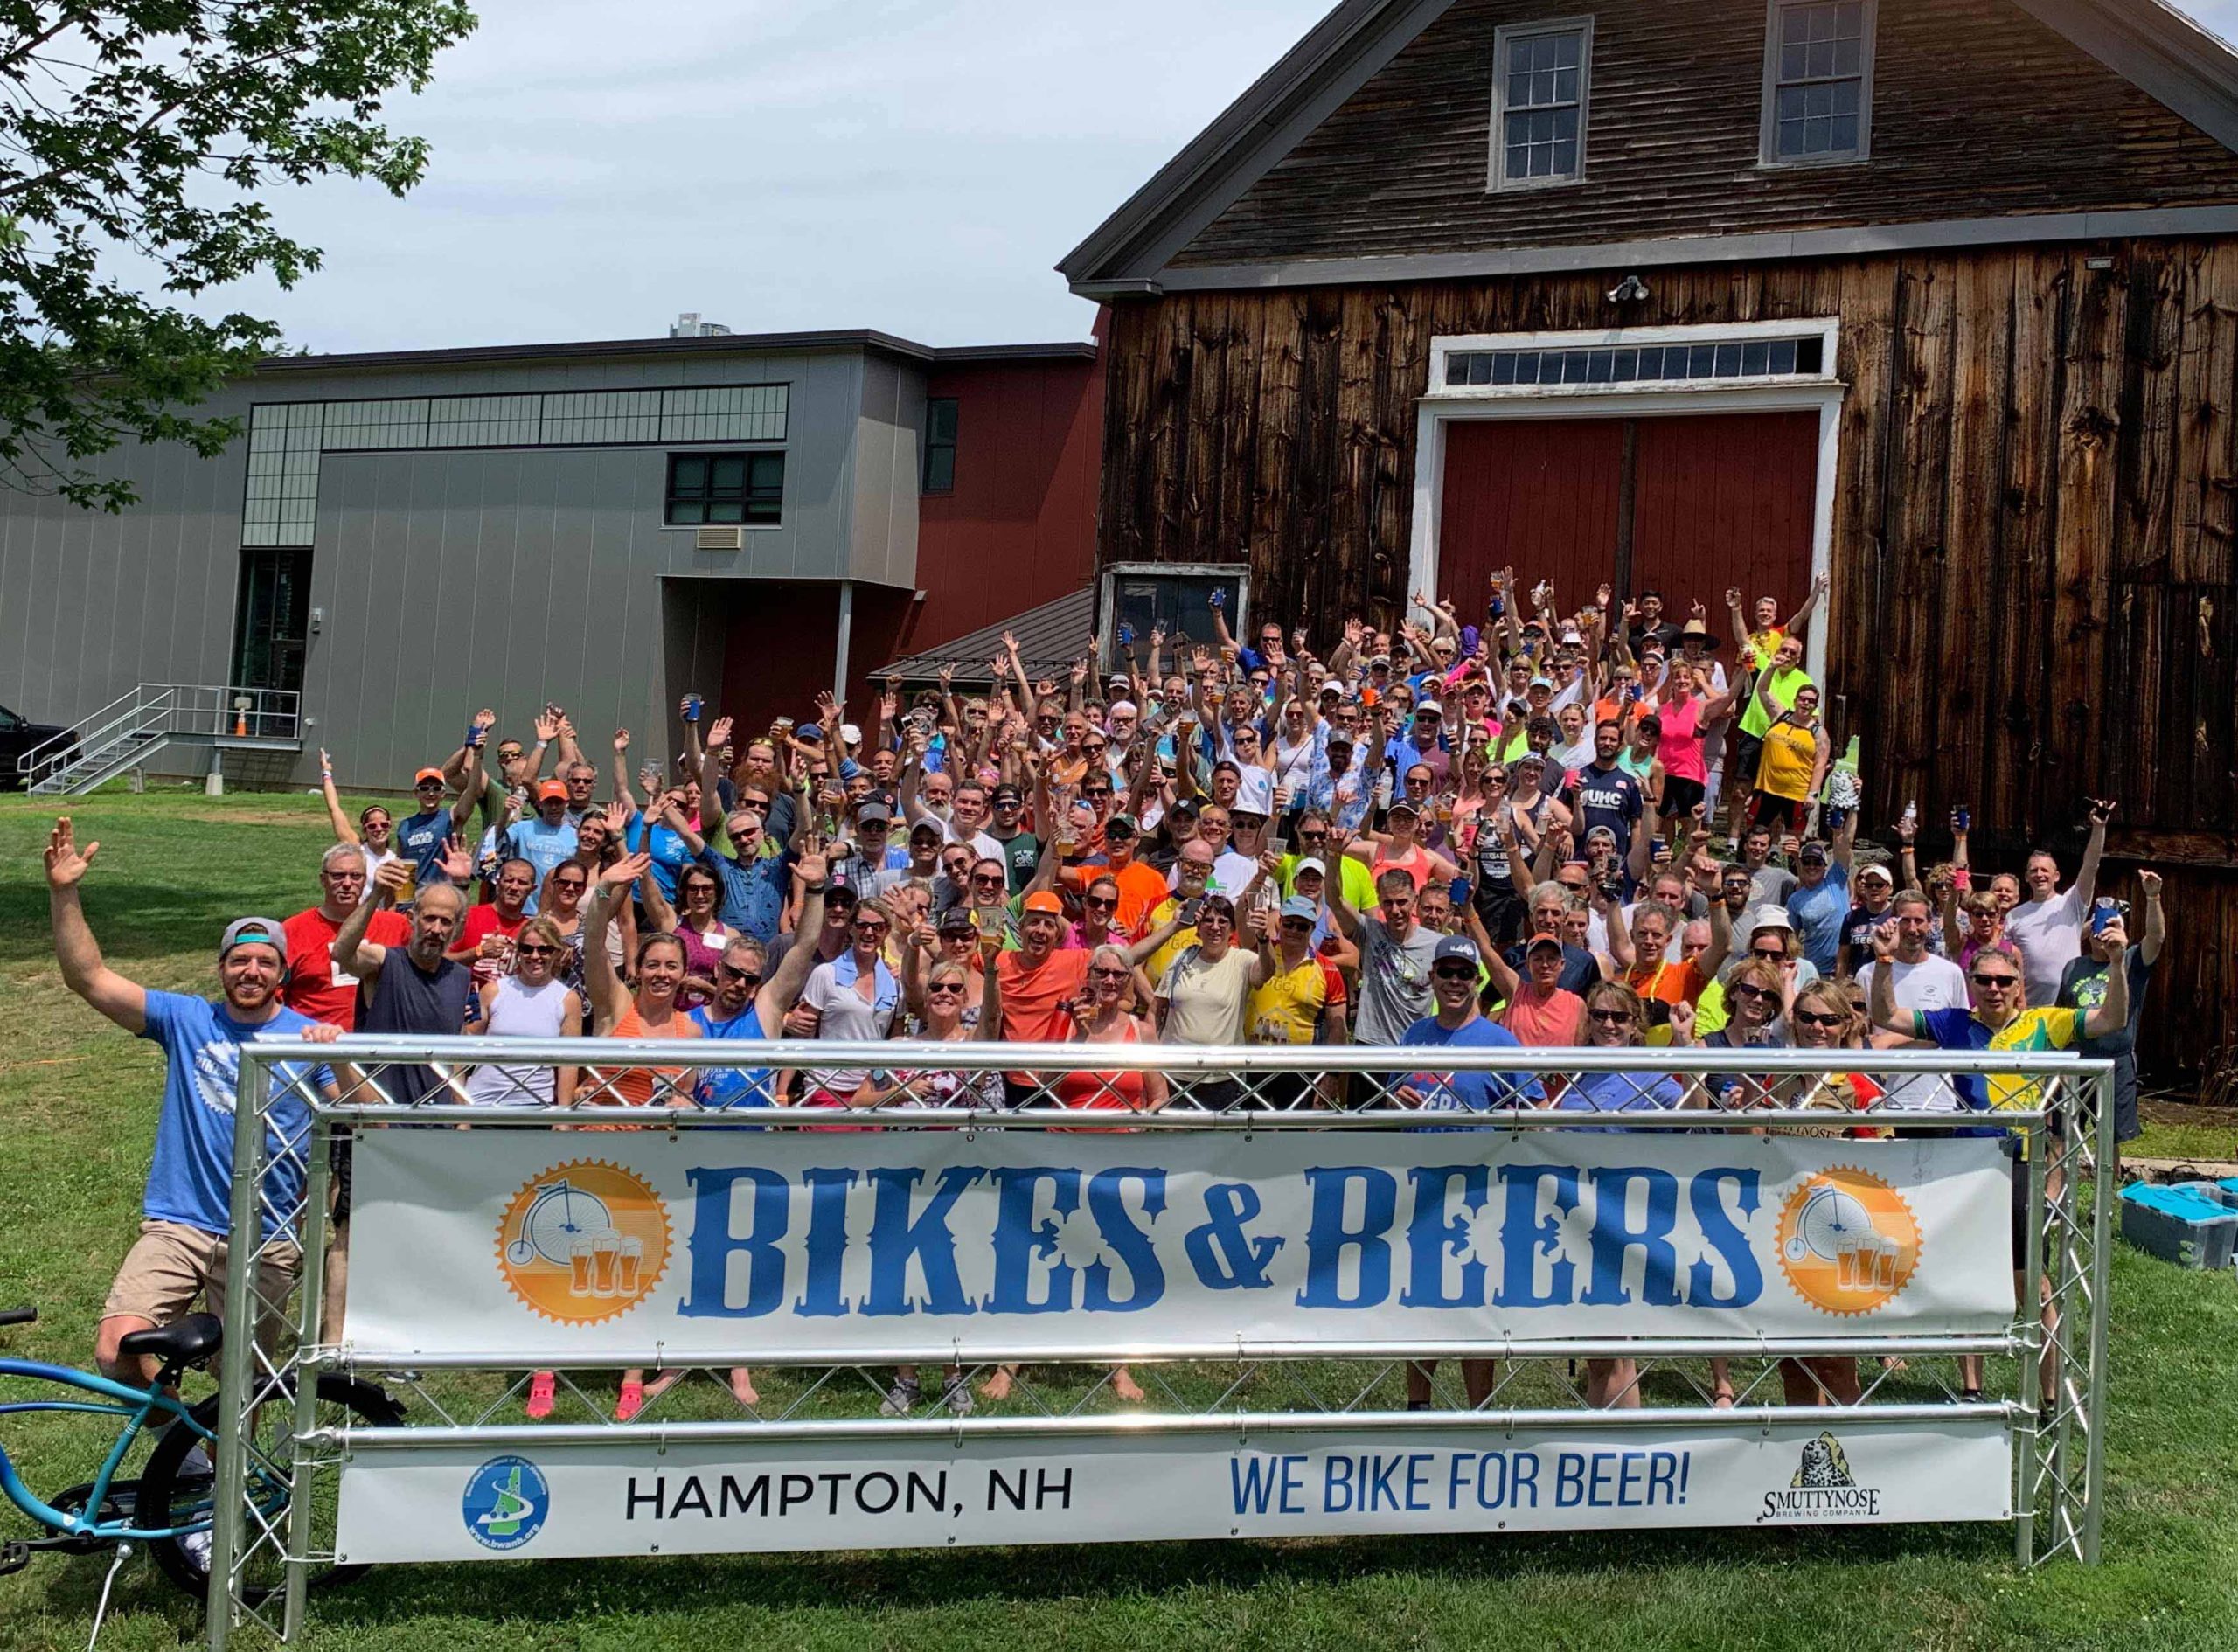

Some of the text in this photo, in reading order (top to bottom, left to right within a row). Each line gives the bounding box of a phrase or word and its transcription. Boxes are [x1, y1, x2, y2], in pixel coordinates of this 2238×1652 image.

[678, 1164, 1764, 1318] BIKES & BEERS
[626, 1468, 1072, 1519] HAMPTON, NH
[1231, 1451, 1691, 1514] WE BIKE FOR BEER!
[1763, 1489, 1880, 1517] SMUTTYNOSE
[1823, 1509, 1868, 1517] COMPANY
